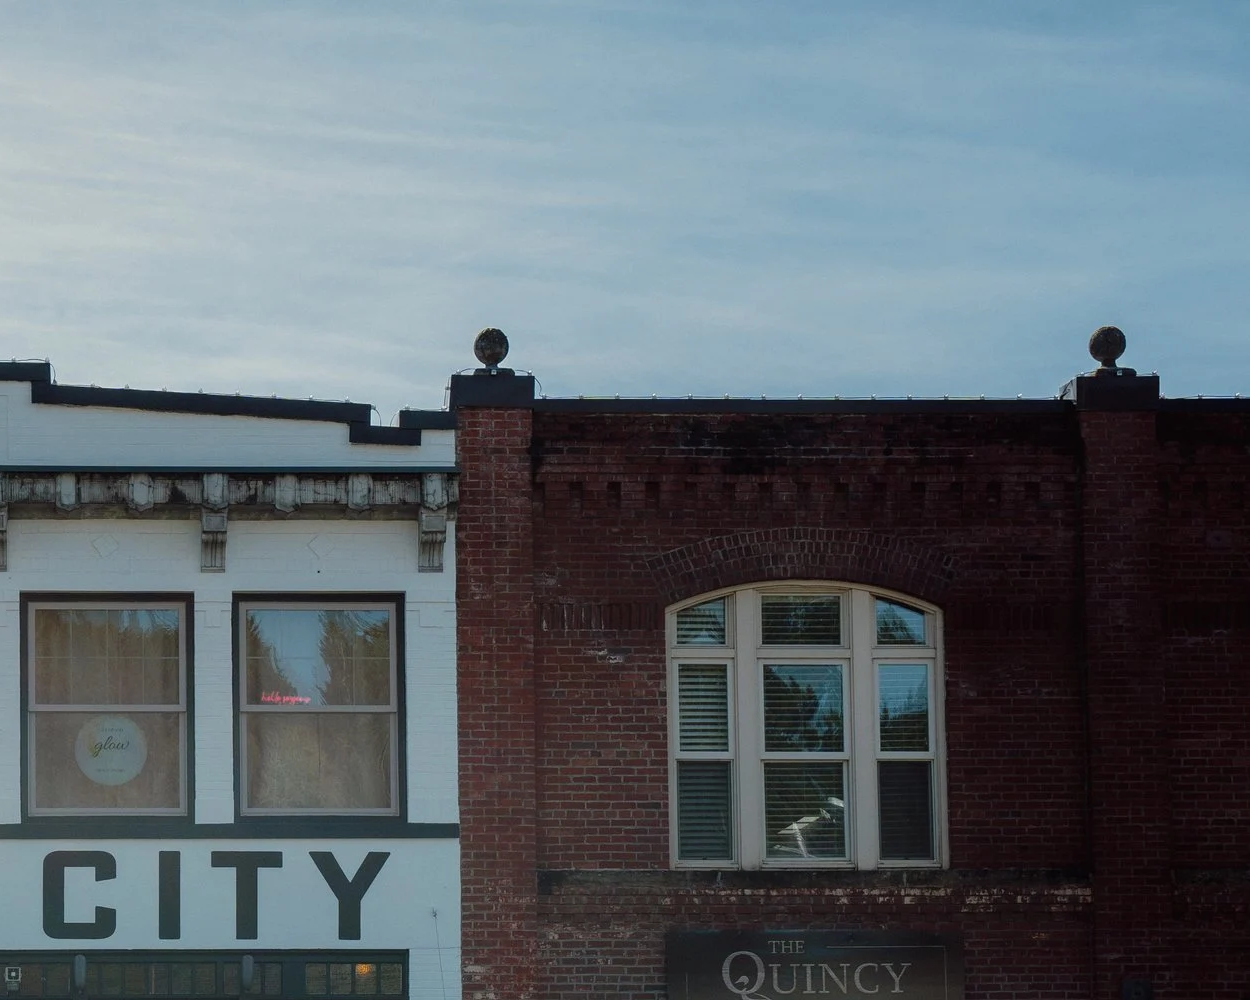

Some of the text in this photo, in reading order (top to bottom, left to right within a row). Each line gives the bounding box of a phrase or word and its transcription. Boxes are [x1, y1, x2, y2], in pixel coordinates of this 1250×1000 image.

[93, 735, 130, 759] glow
[42, 850, 392, 941] CITY
[767, 940, 806, 954] THE
